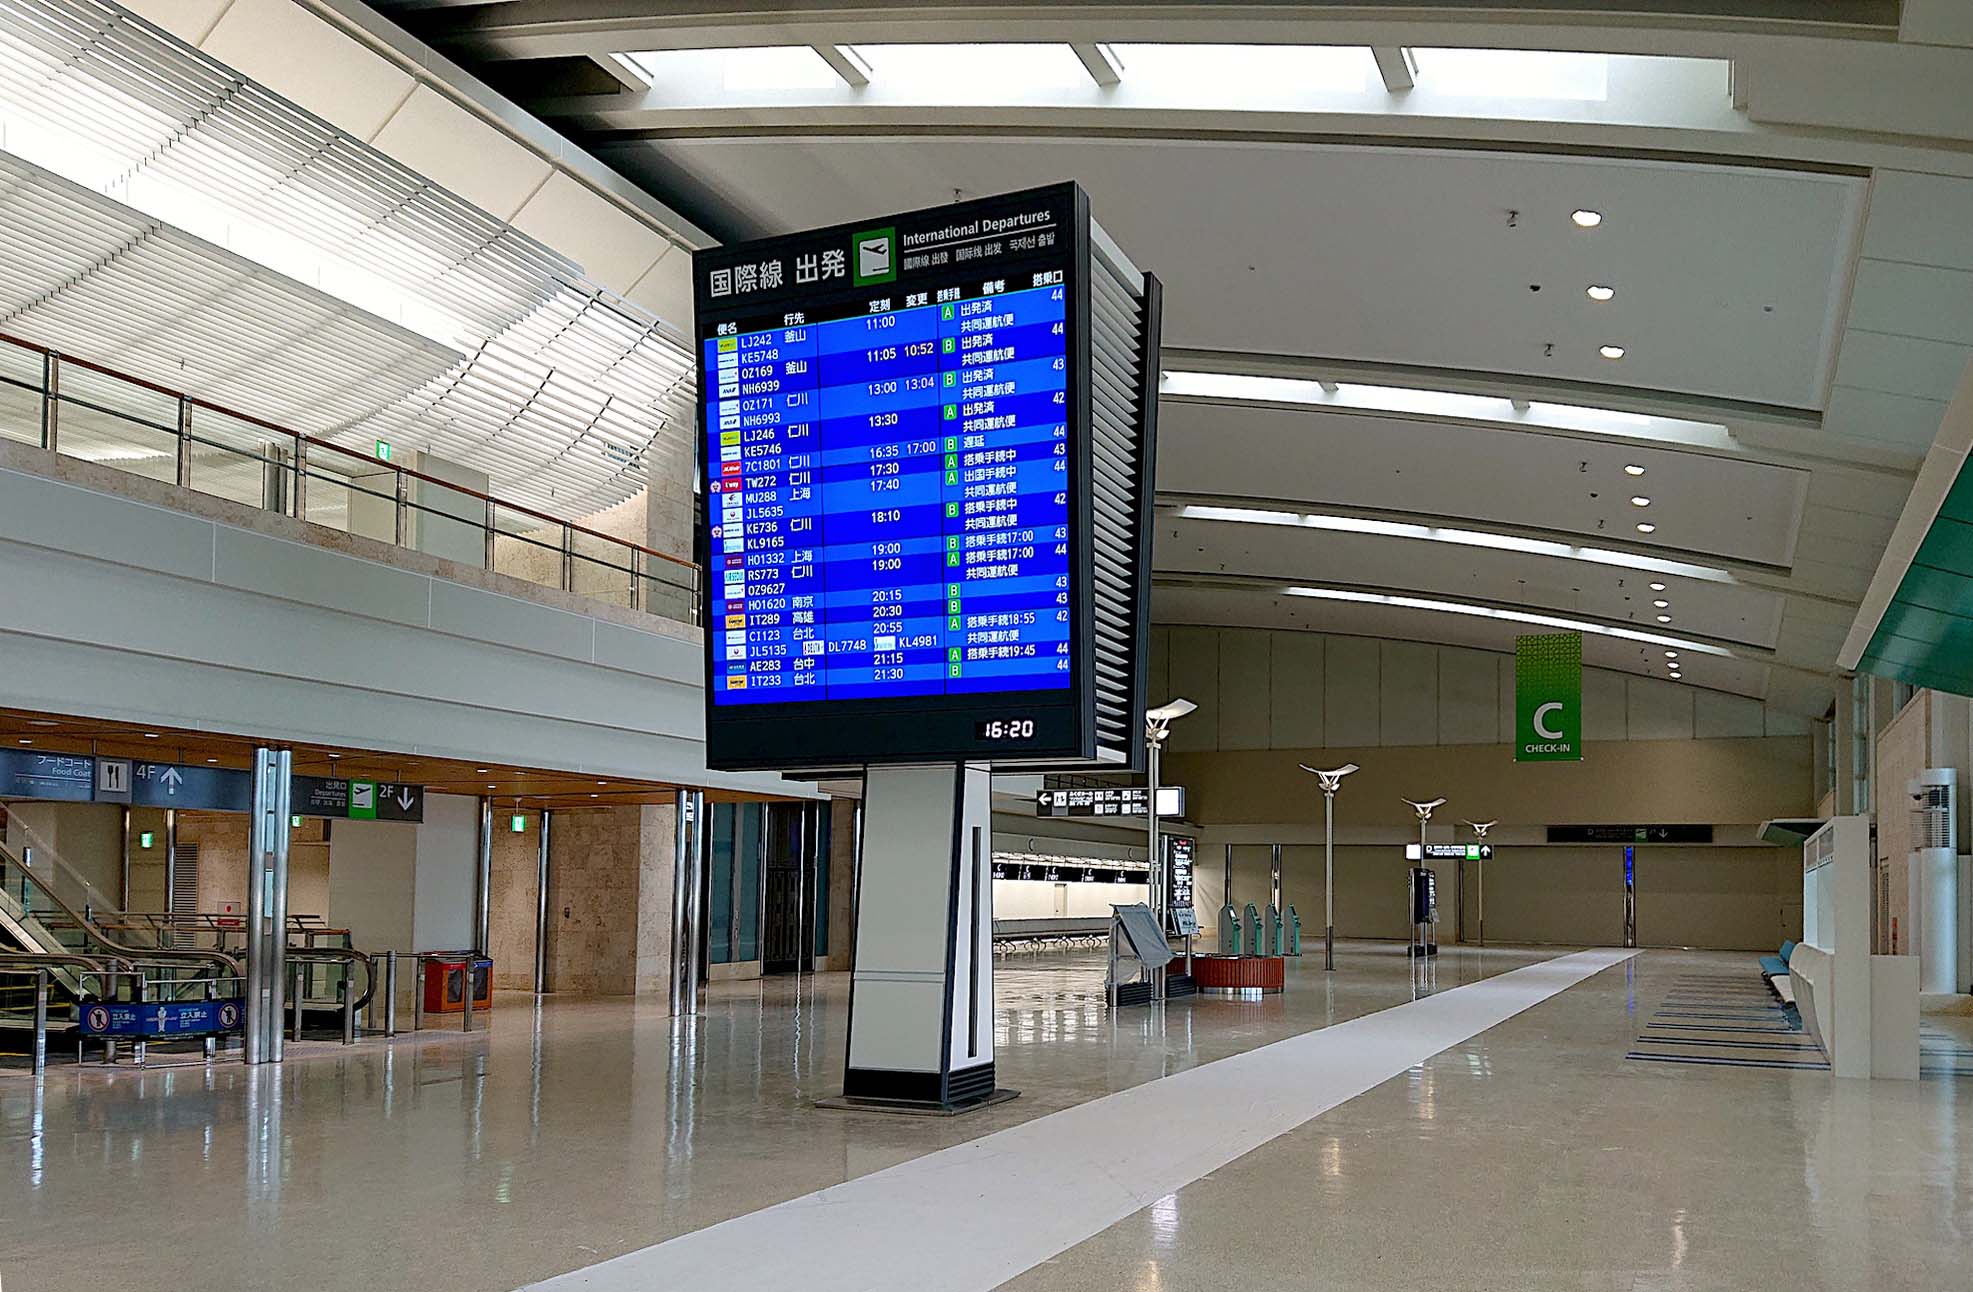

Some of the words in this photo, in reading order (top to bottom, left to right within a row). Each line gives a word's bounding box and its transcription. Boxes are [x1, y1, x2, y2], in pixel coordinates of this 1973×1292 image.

[904, 221, 978, 246] International
[982, 210, 1050, 232] Departures
[1009, 236, 1036, 250] 국제선
[1038, 232, 1055, 246] 출발
[956, 245, 982, 262] 国际线
[984, 242, 1002, 256] 出发
[710, 260, 783, 298] 国際線
[796, 248, 846, 284] 出発
[718, 322, 737, 336] 便名
[784, 312, 804, 326] 行先
[869, 298, 890, 312] 定刻
[906, 292, 928, 307] 変更
[982, 280, 1006, 295] 備考
[1033, 270, 1063, 286] 搭乗口
[742, 334, 772, 348] LJ242
[784, 329, 806, 343] 釜山
[866, 316, 896, 330] 11:00
[961, 300, 992, 316] 出発済
[1051, 288, 1063, 301] 44
[742, 349, 778, 364] KE5748
[961, 314, 1014, 333] 共同運航便
[742, 365, 773, 379] OZ169
[786, 360, 807, 375] 釜山
[867, 348, 896, 362] 11:05
[904, 342, 934, 357] 10:52
[962, 334, 993, 350] 出発済
[1052, 322, 1064, 336] 44
[742, 380, 780, 394] NH6939
[962, 347, 1014, 366] 共同運航便
[743, 398, 773, 411] OZ171
[787, 392, 808, 407] 仁川
[868, 382, 897, 396] 13:00
[906, 377, 934, 390] 13:04
[962, 368, 994, 384] 出発済
[1052, 358, 1064, 371] 43
[744, 412, 780, 426] NH6993
[962, 382, 1016, 400] 共同運航便
[744, 428, 774, 442] LJ246
[788, 424, 808, 438] 仁川
[868, 414, 898, 428] 13:30
[963, 401, 994, 416] 出発済
[1052, 392, 1064, 404] 42
[744, 443, 782, 457] KE5746
[963, 414, 1016, 432] 共同運航便
[745, 459, 780, 472] 7C1801
[789, 455, 810, 469] 仁川
[870, 445, 898, 458] 16:35
[907, 441, 936, 454] 17:00
[1054, 425, 1064, 438] 44
[745, 476, 776, 489] TW272
[789, 471, 810, 486] 仁川
[870, 462, 899, 476] 17:30
[964, 449, 1016, 466] 搭乗手続中
[1054, 443, 1066, 455] 43
[746, 491, 776, 504] MU288
[789, 488, 810, 501] 上海
[870, 478, 900, 492] 17:40
[964, 466, 1016, 482] 出国手続中
[1054, 459, 1066, 472] 44
[746, 506, 784, 519] JL5635
[964, 482, 1017, 498] 共同運航便
[746, 522, 778, 534] KE736
[790, 518, 812, 532] 仁川
[872, 510, 900, 523] 18:10
[965, 498, 1017, 514] 搭乗手続中
[1054, 492, 1066, 505] 42
[747, 536, 784, 550] KL9165
[965, 514, 1018, 530] 共同運航便
[792, 550, 812, 564] 上海
[872, 543, 900, 556] 19:00
[1055, 528, 1066, 540] 43
[748, 569, 779, 581] RS773
[792, 565, 812, 578] 仁川
[872, 558, 901, 571] 19:00
[1055, 543, 1066, 556] 44
[748, 584, 785, 596] OZ9627
[966, 564, 1018, 580] 共同運航便
[750, 614, 780, 626] IT289
[792, 611, 814, 624] 高雄
[873, 605, 902, 618] 20:30
[1056, 592, 1068, 604] 43
[792, 596, 814, 608] 南京
[872, 590, 902, 602] 20:15
[1056, 576, 1067, 588] 43
[750, 630, 780, 642] CI123
[792, 627, 814, 640] 台北
[874, 622, 902, 634] 20:55
[1056, 610, 1068, 622] 42
[750, 645, 786, 657] JL5135
[828, 640, 866, 652] DL7748
[899, 635, 936, 648] KL4981
[968, 630, 1019, 644] 共同運航便
[750, 660, 781, 672] AE283
[793, 658, 814, 671] 台中
[874, 653, 903, 665] 21:15
[1056, 642, 1068, 654] 44
[752, 675, 782, 686] IT233
[794, 672, 816, 686] 台北
[874, 668, 904, 680] 21:30
[1057, 659, 1068, 670] 44
[986, 720, 1034, 738] 16:20
[1534, 702, 1563, 739] C
[38, 756, 92, 768] フードコート
[1526, 744, 1570, 753] CHECK-IN
[52, 767, 72, 776] Food
[136, 764, 156, 780] 4F
[379, 784, 394, 798] 2F
[1426, 845, 1432, 854] D
